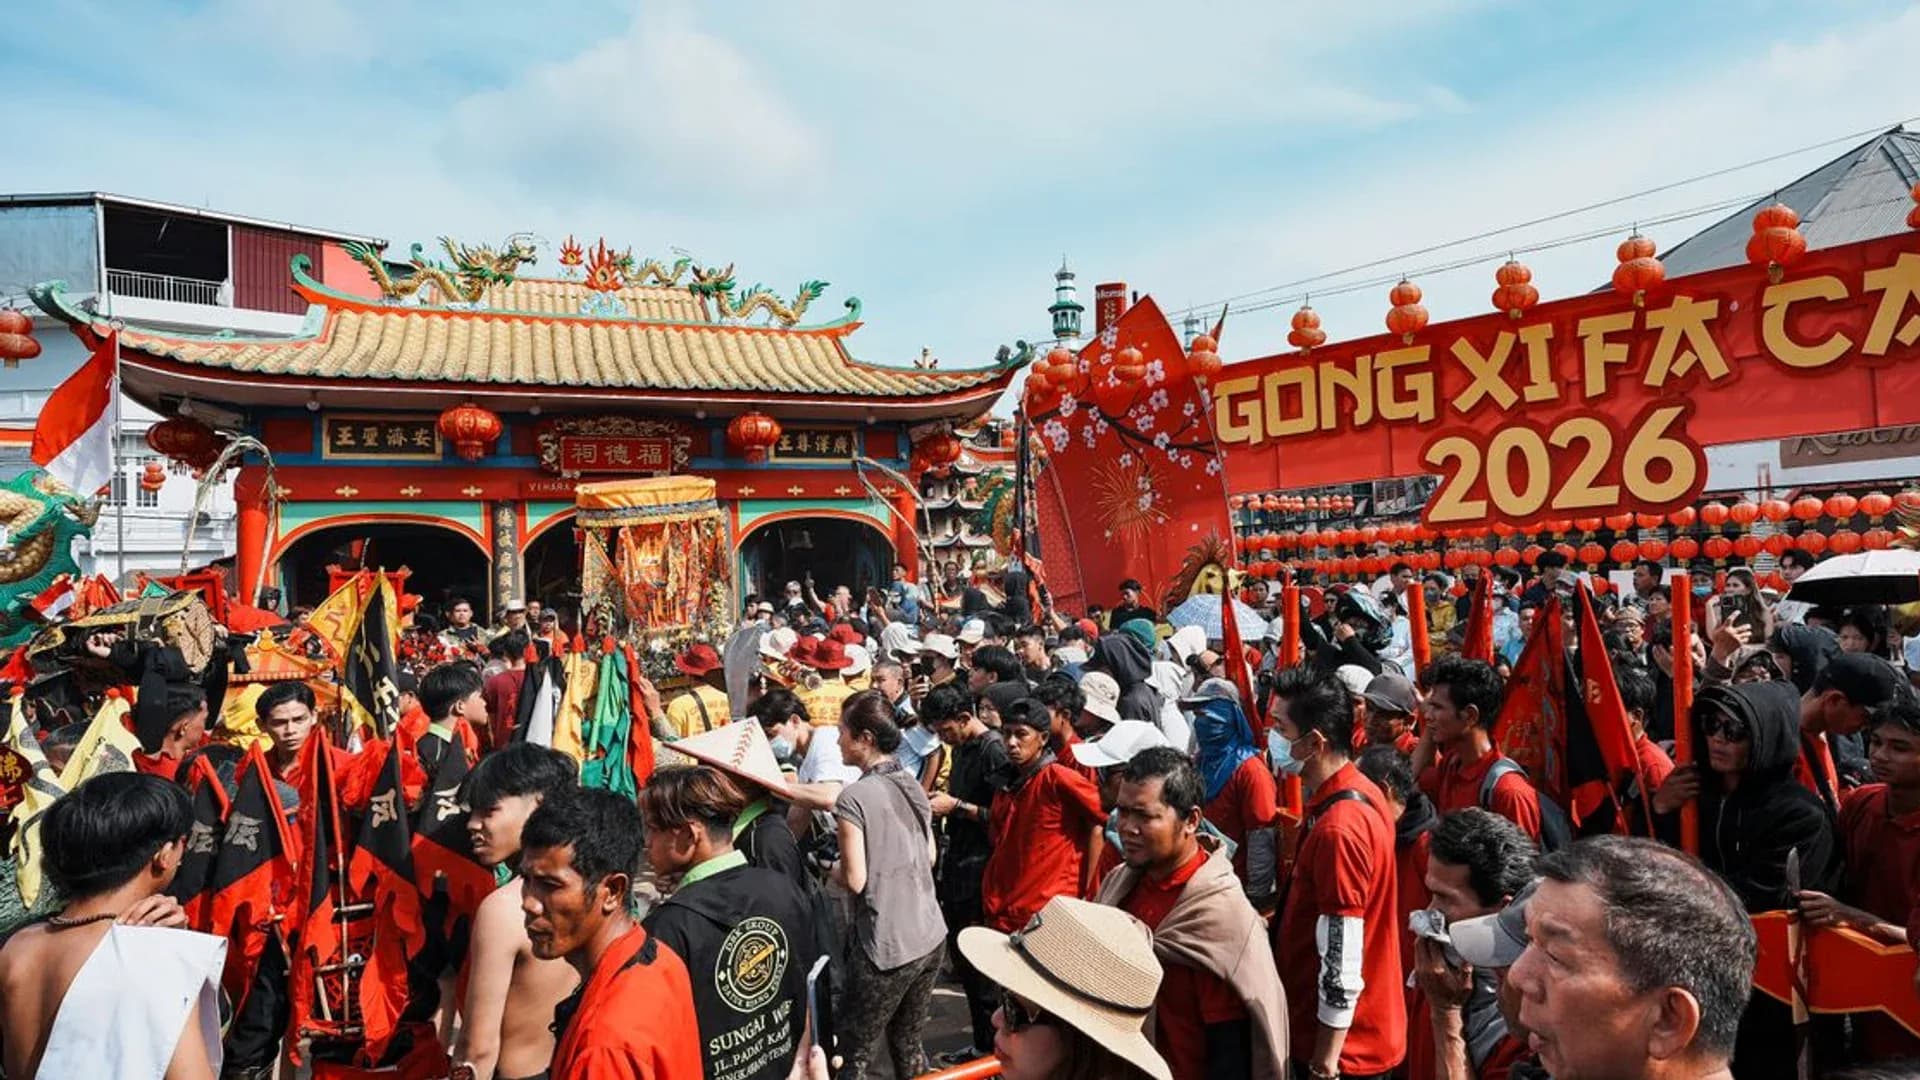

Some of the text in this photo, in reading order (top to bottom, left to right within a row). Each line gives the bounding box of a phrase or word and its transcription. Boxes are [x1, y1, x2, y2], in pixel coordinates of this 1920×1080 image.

[1213, 344, 1435, 446] GONG
[1450, 322, 1560, 413] XI
[1577, 295, 1730, 398] FA
[529, 482, 570, 492] VIHARA
[1425, 406, 1696, 522] 2026
[709, 1014, 766, 1055] SUNGAI
